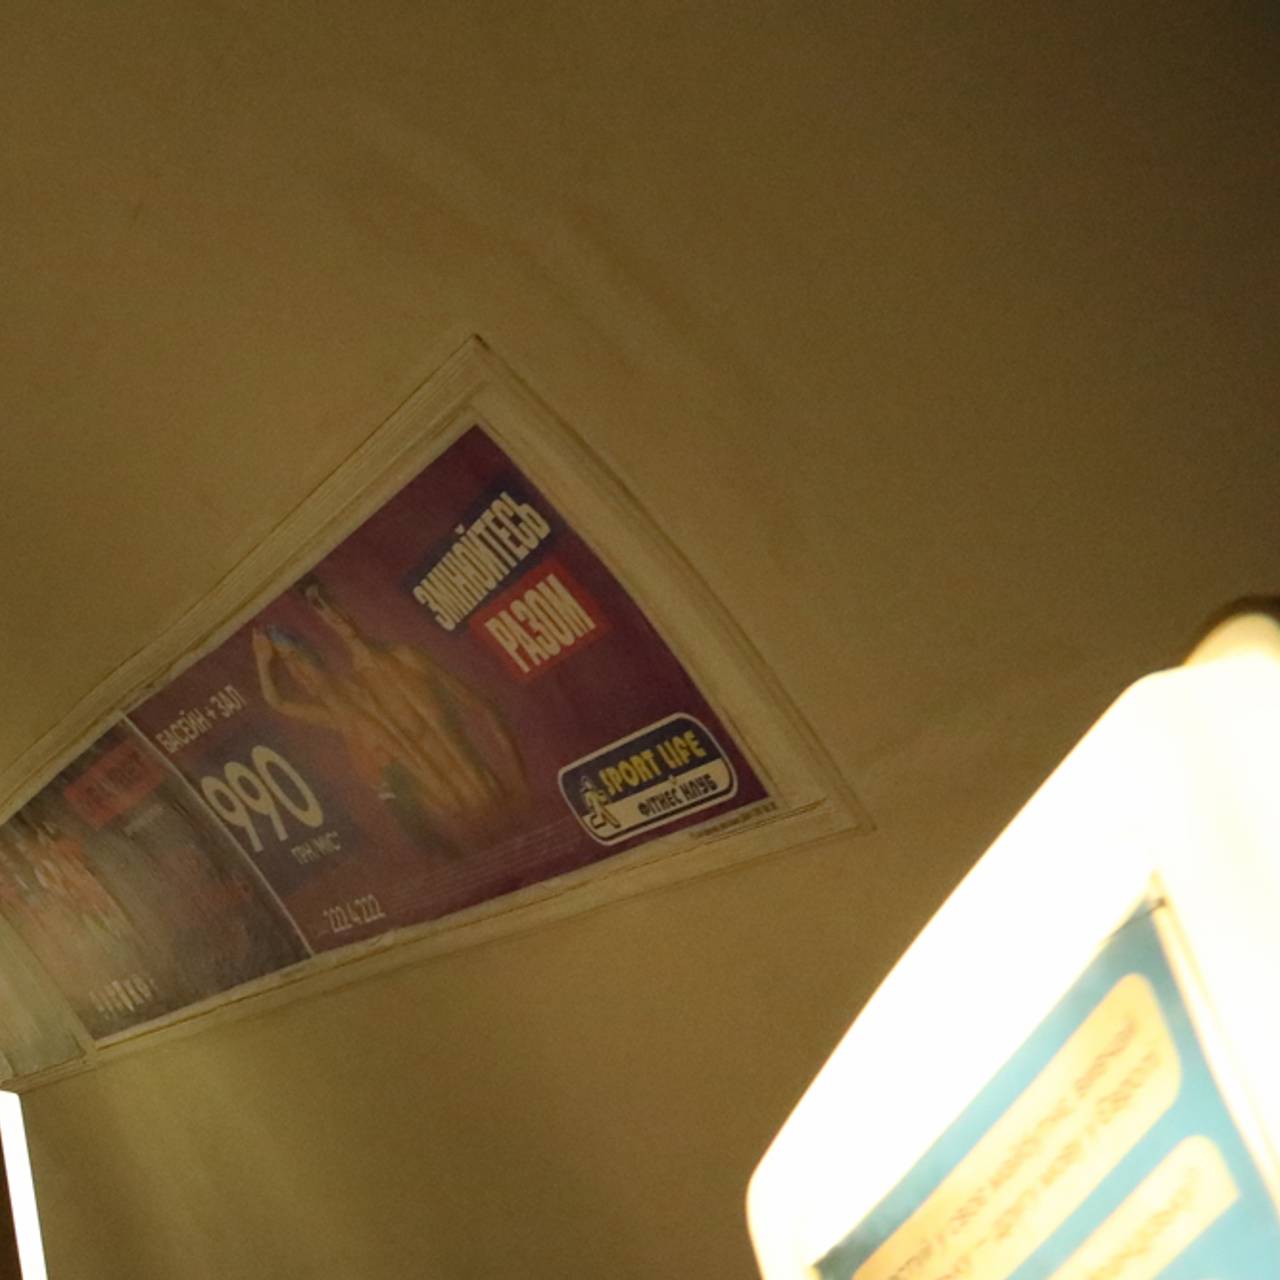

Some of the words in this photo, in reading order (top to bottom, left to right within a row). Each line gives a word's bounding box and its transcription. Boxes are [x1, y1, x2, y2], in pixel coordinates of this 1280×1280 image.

[412, 491, 552, 632] ЗМІНЮЙТЕСЬ
[484, 573, 598, 673] РАЗОМ
[155, 710, 213, 754] БАСЕЙН
[209, 684, 248, 718] ЗАЛ
[598, 749, 660, 797] SPORT
[660, 729, 708, 770] LIFE
[200, 745, 324, 853] 990
